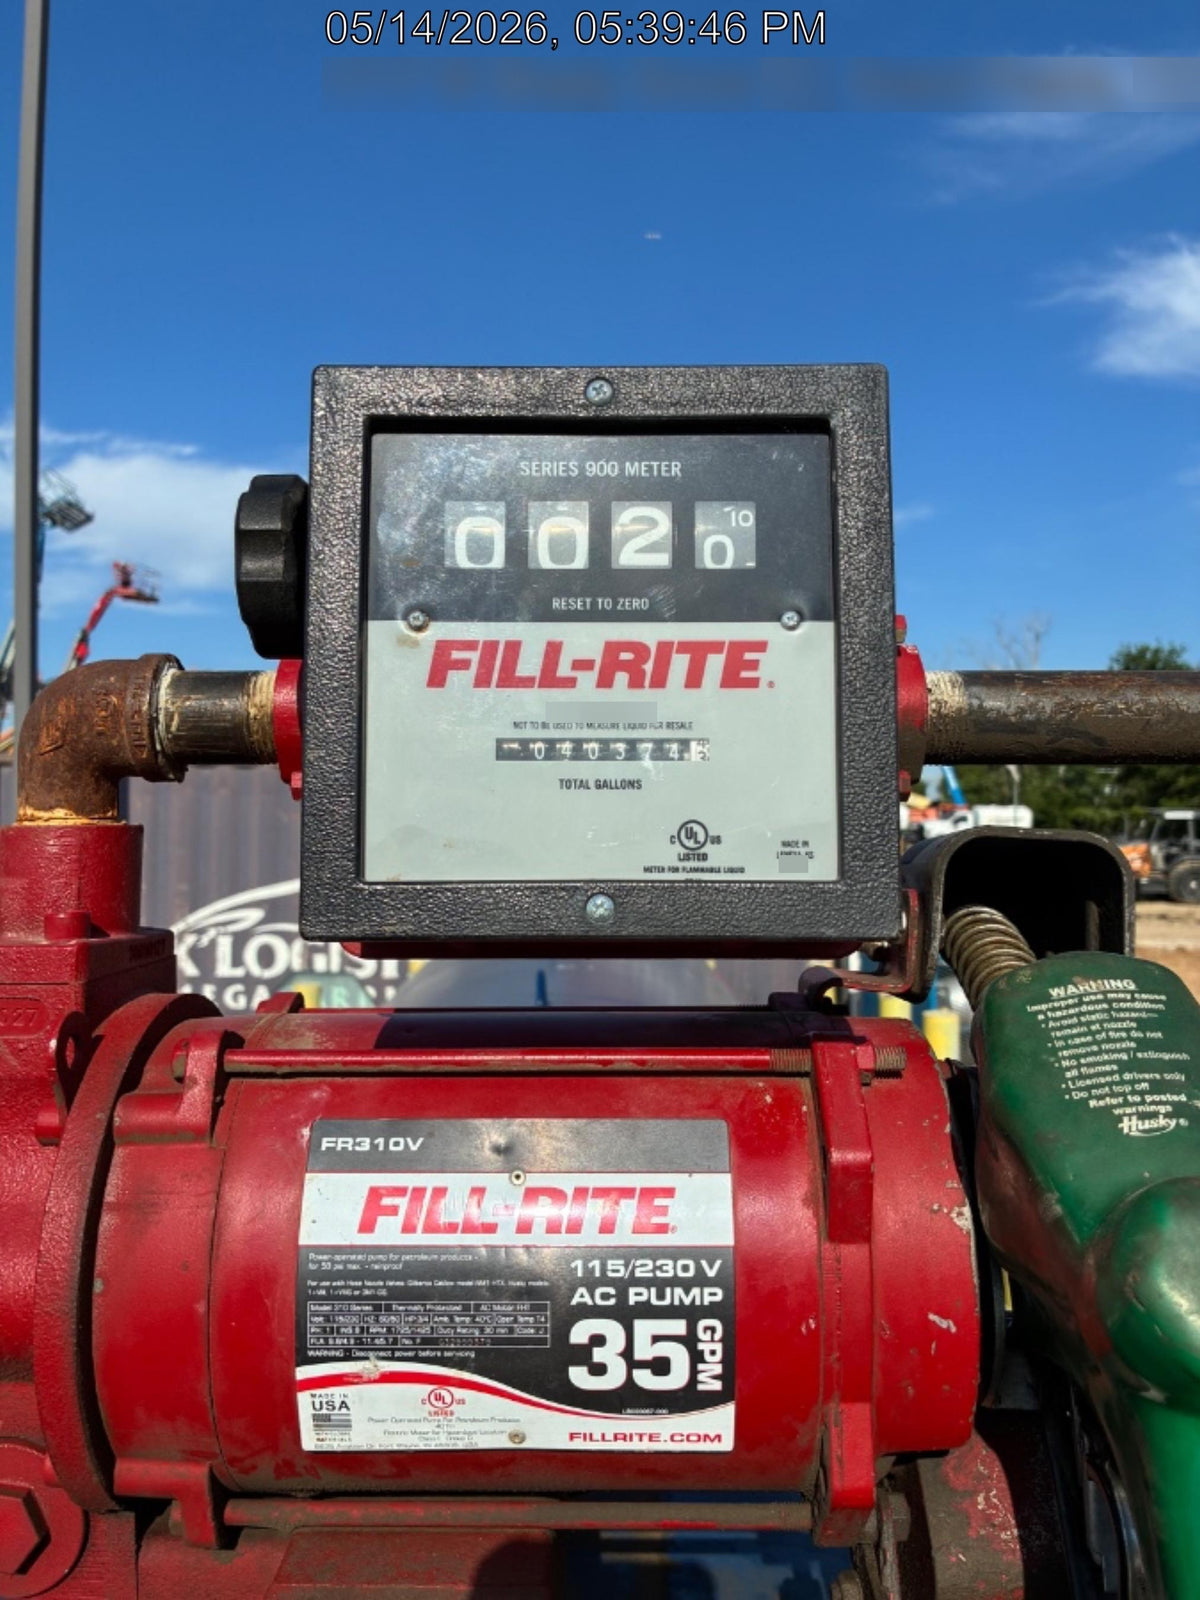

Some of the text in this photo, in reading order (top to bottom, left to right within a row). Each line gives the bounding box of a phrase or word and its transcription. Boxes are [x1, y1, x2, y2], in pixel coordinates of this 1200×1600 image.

[520, 461, 682, 477] SERIES 900 METER
[552, 598, 649, 610] RESET TO ZERO
[666, 721, 692, 730] RESALE
[559, 779, 642, 790] TOTAL GALLONS
[678, 853, 708, 861] LISTED
[1049, 979, 1136, 996] WARNING
[1026, 997, 1079, 1013] Improper
[1082, 993, 1104, 1001] use
[1107, 992, 1131, 1001] may
[1047, 1003, 1109, 1018] hazardous
[1112, 1001, 1165, 1011] condition
[1048, 1016, 1079, 1028] Avoid
[1080, 1012, 1109, 1022] static
[1051, 1026, 1088, 1038] remain
[1103, 1020, 1137, 1029] nozzle
[1069, 1035, 1092, 1045] case
[1096, 1032, 1107, 1041] of
[1058, 1046, 1099, 1057] remove
[1061, 1058, 1077, 1068] No
[1081, 1052, 1129, 1065] smoking
[1081, 1064, 1119, 1076] flames
[1068, 1074, 1119, 1089] Licensed
[1122, 1071, 1161, 1080] drivers
[1072, 1091, 1089, 1100] Do
[1091, 1087, 1111, 1096] not
[1113, 1083, 1132, 1094] top
[1088, 1093, 1187, 1109] Refer to posted
[1112, 1104, 1173, 1115] warnings
[1118, 1114, 1177, 1136] Husky
[320, 1137, 424, 1151] FR310V
[570, 1259, 722, 1279] 115/230 V
[570, 1287, 723, 1305] AC PUMP
[568, 1319, 690, 1390] 35
[697, 1318, 723, 1391] GPM
[312, 1400, 350, 1411] USA
[569, 1432, 722, 1442] FILLRITE.COM
